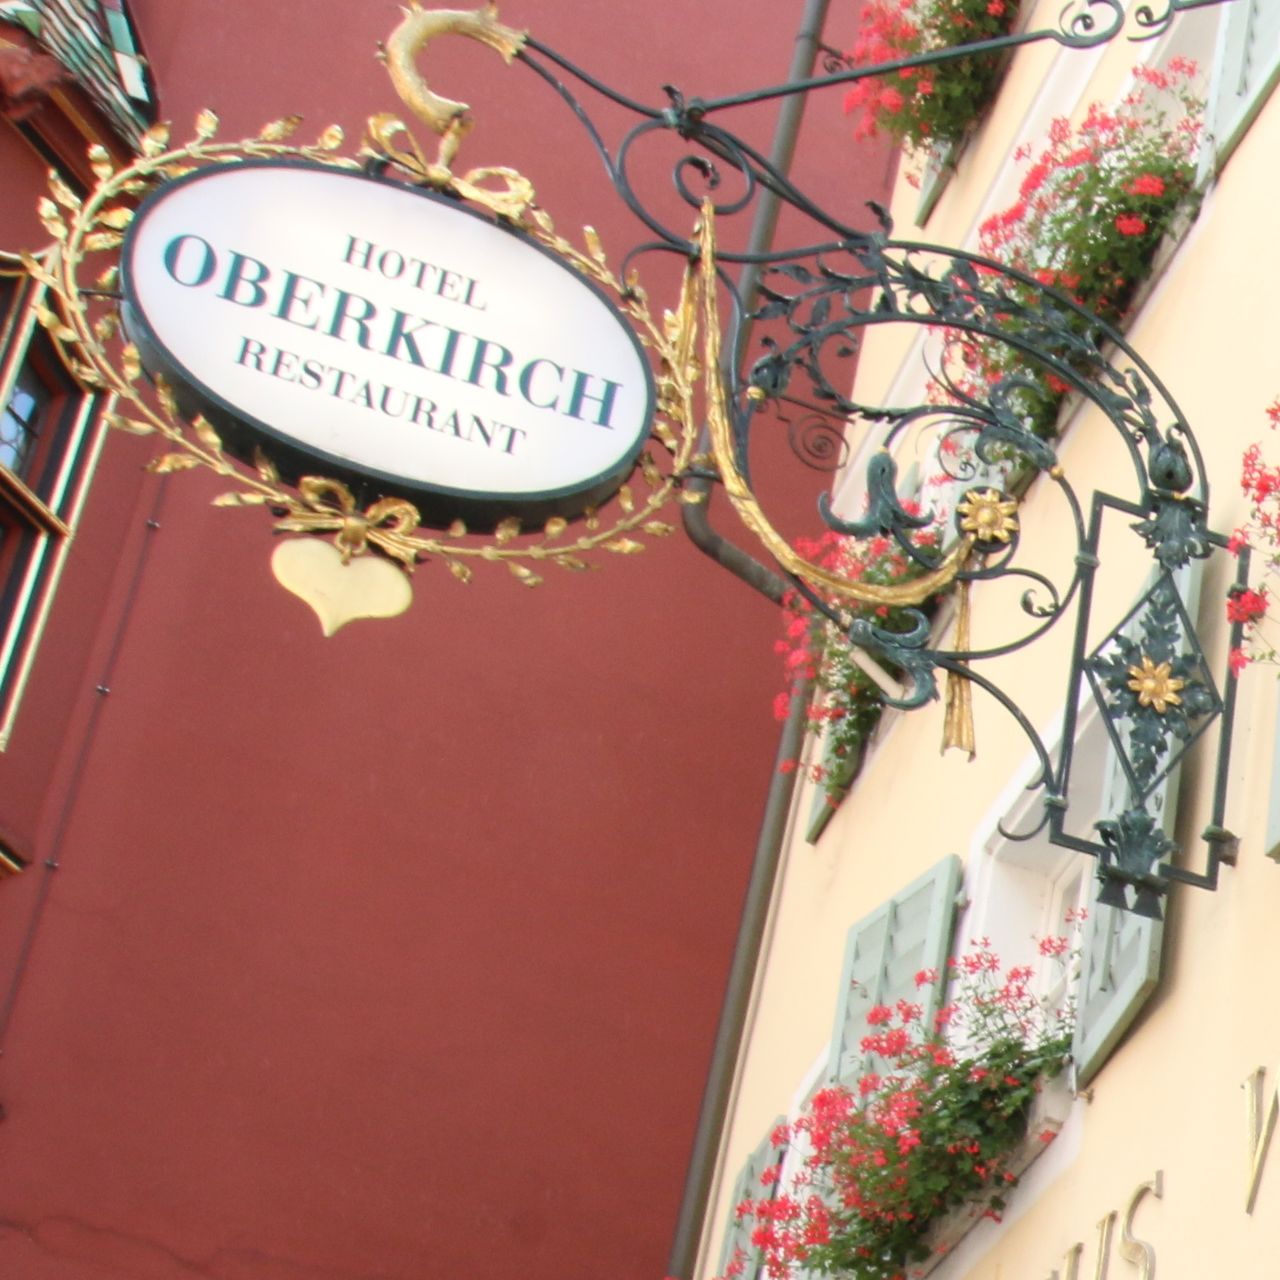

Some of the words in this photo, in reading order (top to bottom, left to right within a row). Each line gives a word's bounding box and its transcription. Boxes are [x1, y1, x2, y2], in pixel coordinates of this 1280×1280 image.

[163, 233, 624, 430] OBERKIRCH
[342, 234, 487, 311] HOTEL
[234, 336, 527, 456] RESTAURANT
